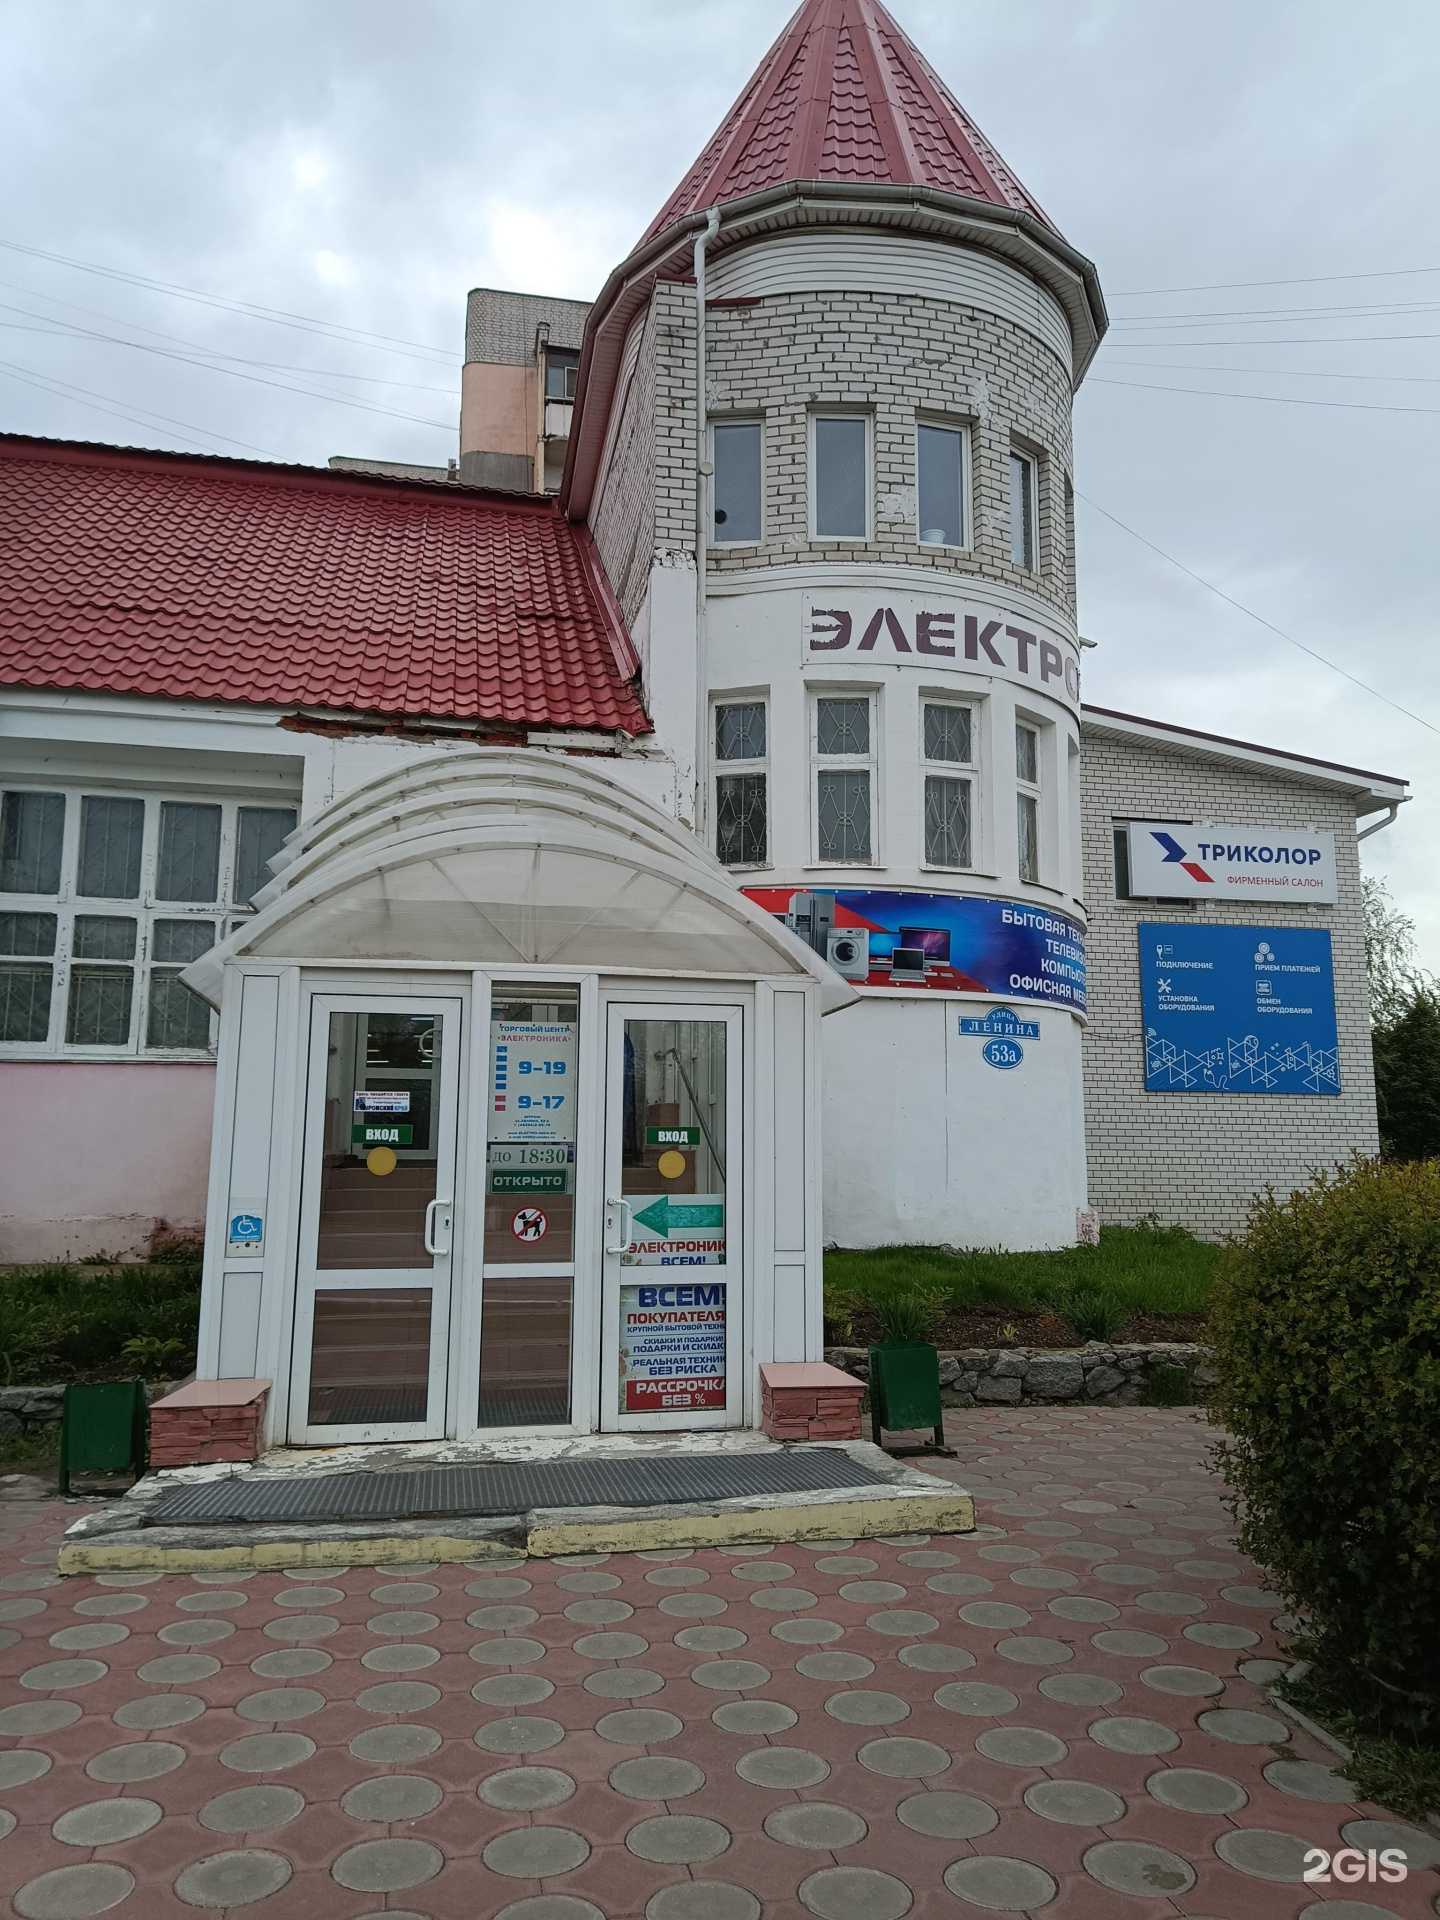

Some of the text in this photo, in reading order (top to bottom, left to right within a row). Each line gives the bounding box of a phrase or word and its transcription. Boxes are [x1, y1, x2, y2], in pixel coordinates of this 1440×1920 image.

[1197, 843, 1321, 865] ТРИКОЛОР
[1227, 874, 1323, 888] ФИРМЕННЫЙ САЛОН
[1002, 909, 1066, 937] БЫТОВАЯ
[1156, 961, 1214, 970] ПОДКЛЮЧЕНИЕ
[1255, 964, 1321, 973] ПРИЕМ ПЛАТЕЖЕЙ
[1009, 974, 1072, 999] ОФИСНАЯ
[1257, 997, 1281, 1005] ОБМЕН
[1158, 1003, 1215, 1012] ОБОРУДОВАНИЯ
[1257, 1006, 1313, 1015] ОБОРУДОВАНИЯ
[991, 1011, 1015, 1022] УЛИЦА
[500, 1025, 543, 1033] ТОРГОВЫЙ
[969, 1021, 1034, 1036] ЛЕНИНА
[991, 1044, 1017, 1062] 53а
[518, 1061, 567, 1075] 9-19
[518, 1095, 565, 1109] 9-17
[365, 1129, 399, 1142] ВХОД
[658, 1130, 689, 1143] ВХОД
[520, 1148, 565, 1164] 18:30
[493, 1176, 562, 1186] ОТКРЫТО
[627, 1324, 663, 1334] КРУПНОЙ
[665, 1323, 702, 1332] БЫТОВОЙ
[643, 1337, 676, 1345] СКИДКИ
[633, 1344, 680, 1353] ПОДАРКИ
[683, 1343, 690, 1351] И
[633, 1357, 686, 1367] РЕАЛЬНАЯ
[649, 1364, 718, 1376] БЕЗ РИСКА
[662, 1393, 706, 1406] БЕЗ %
